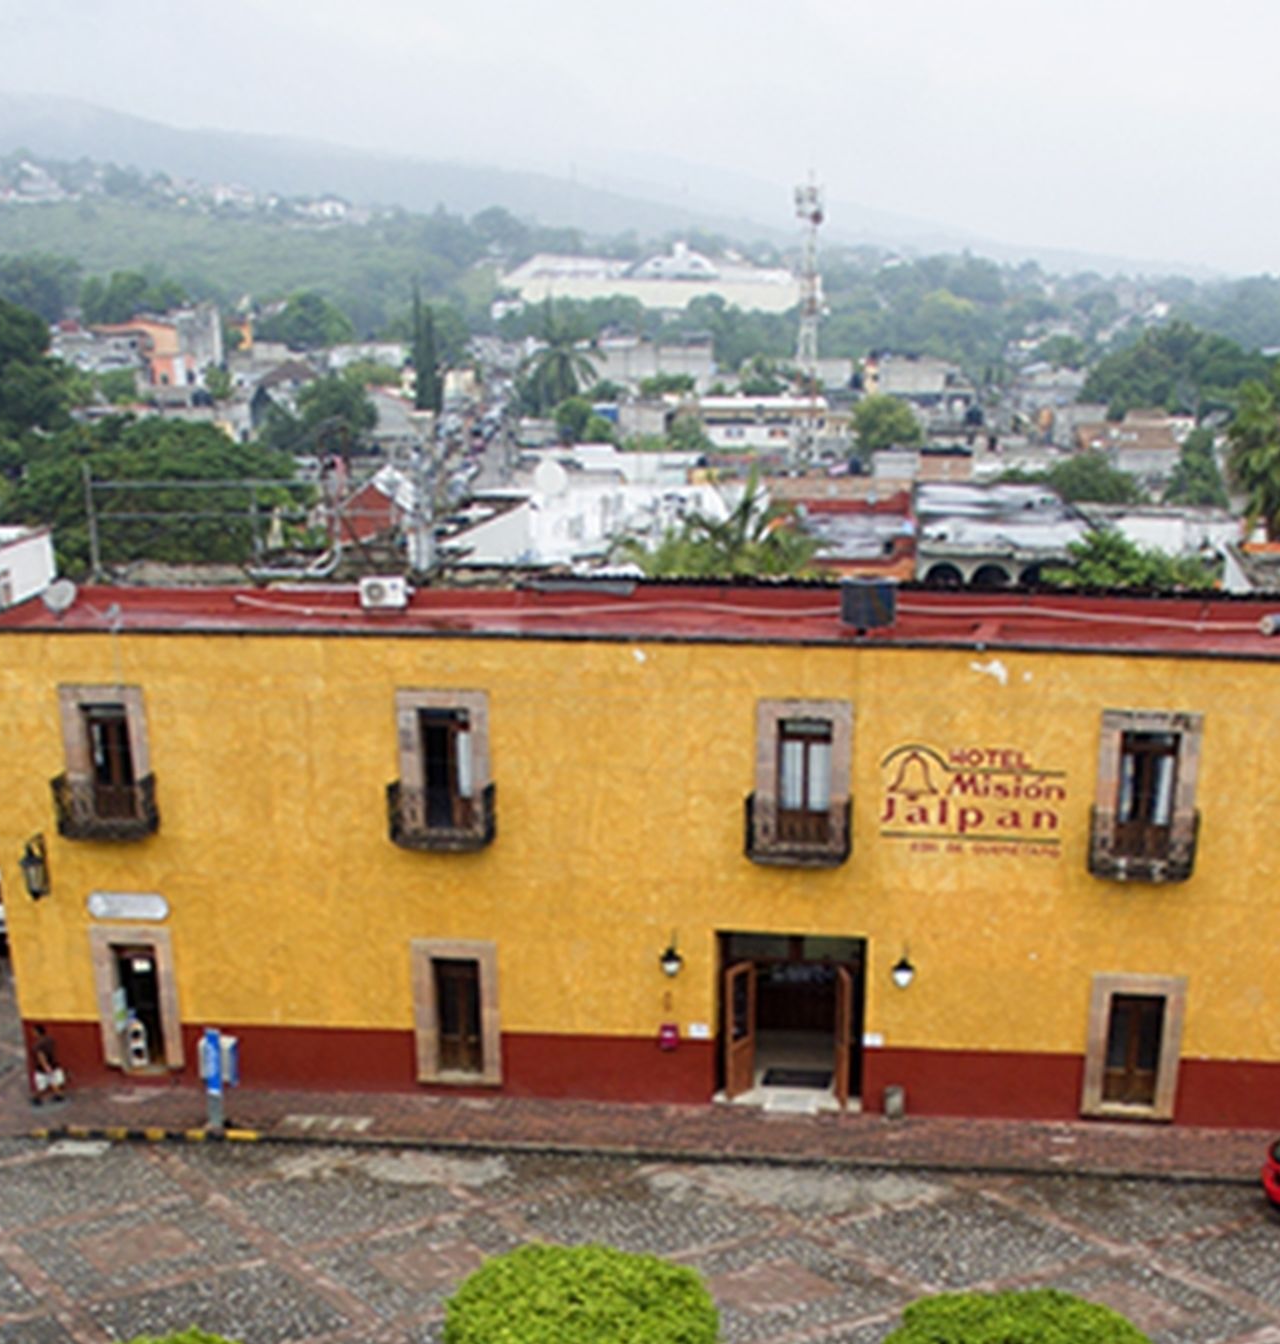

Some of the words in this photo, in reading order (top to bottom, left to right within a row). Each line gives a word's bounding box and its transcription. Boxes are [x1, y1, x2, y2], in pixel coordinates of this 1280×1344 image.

[949, 748, 1032, 770] HOTEL
[946, 774, 1066, 800] Misión
[880, 797, 1059, 833] Jalpan
